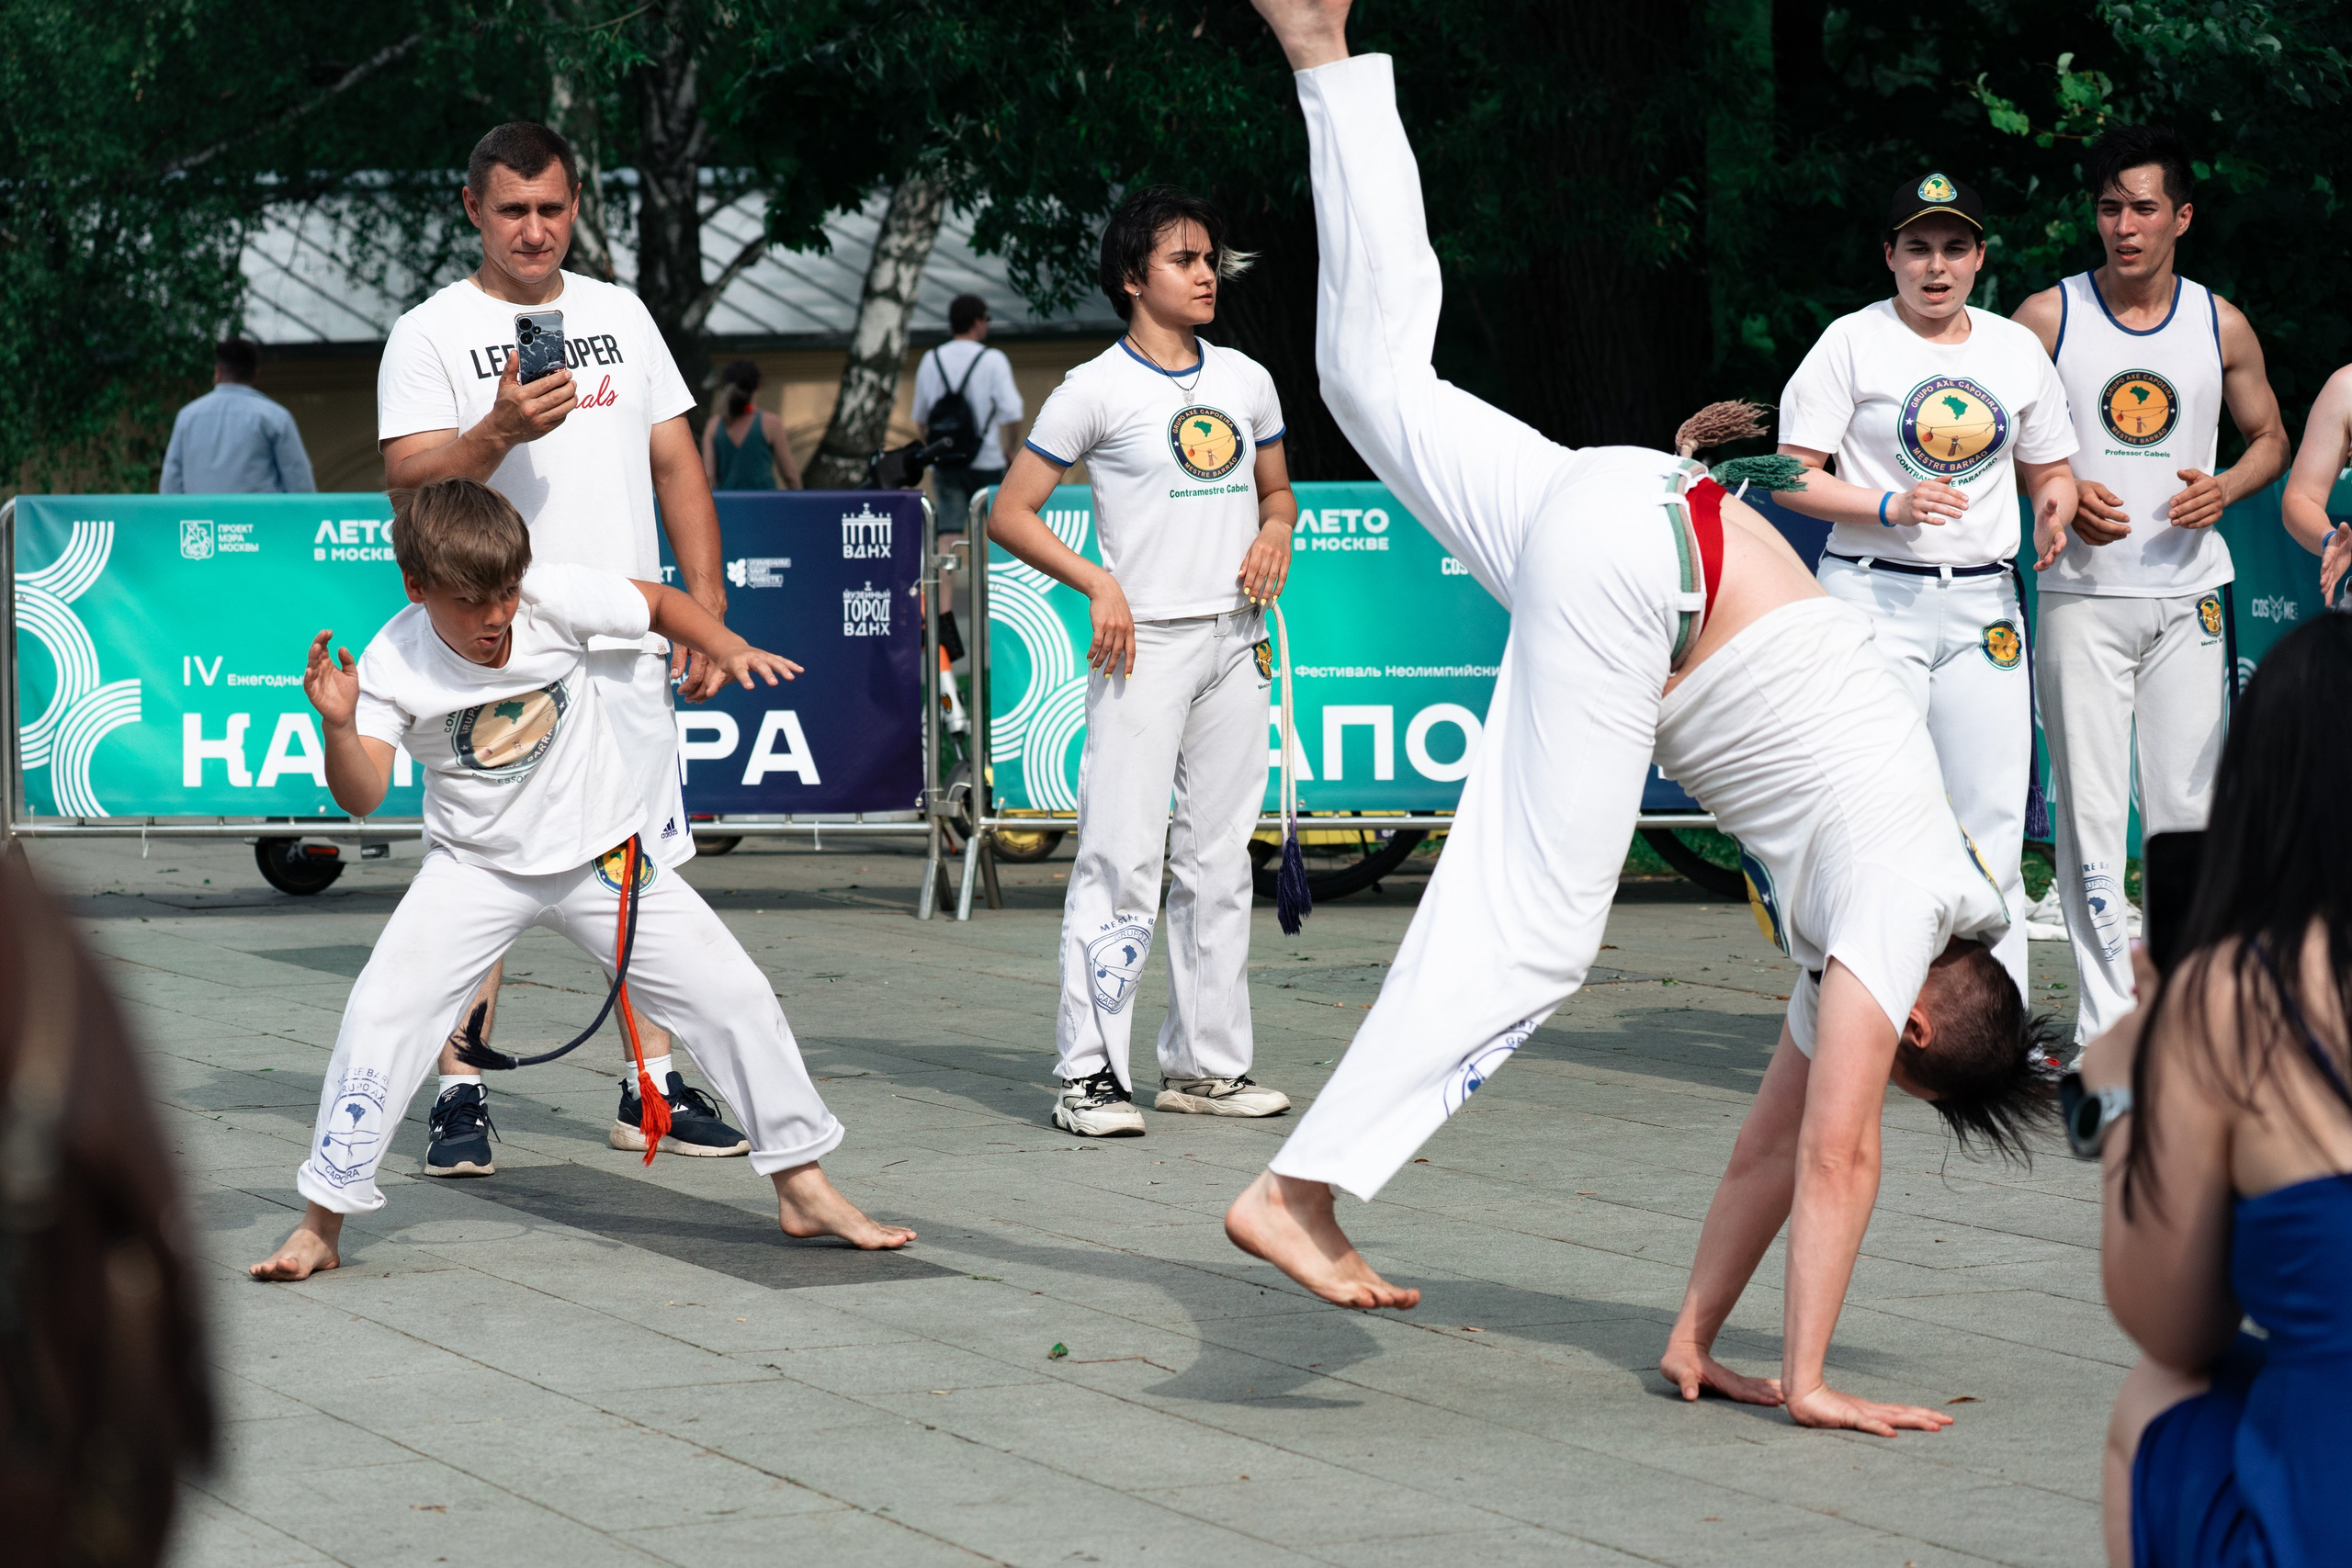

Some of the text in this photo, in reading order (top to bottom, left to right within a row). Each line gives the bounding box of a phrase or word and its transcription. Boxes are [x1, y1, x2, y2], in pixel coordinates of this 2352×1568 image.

[566, 334, 624, 369] OPER
[2106, 378, 2125, 398] GRUPO
[2143, 374, 2174, 400] CAPOEIRA
[1911, 387, 1934, 408] GRUPO
[1958, 380, 1999, 413] CAPOEIRA
[1172, 415, 1185, 434] GRUPO
[1200, 409, 1234, 428] CAPOEIRA
[2111, 426, 2137, 444] MESTRE
[1913, 447, 1946, 471] MESTRE
[1184, 462, 1210, 478] MESTRE
[1958, 457, 1998, 486] PARAFUSO
[1170, 483, 1249, 499] Contramestre Cabelo
[218, 524, 254, 533] ПРОЕКТ
[1295, 508, 1390, 534] ЛЕТО
[218, 534, 244, 542] МЭРА
[1295, 537, 1390, 551] В МОСКВЕ
[218, 543, 259, 552] МОСКВЫ
[313, 547, 396, 561] В МОСКВ
[842, 544, 891, 558] ВДНХ
[842, 599, 891, 622] ГОРОД
[843, 622, 890, 637] ВДНХ
[184, 655, 223, 686] IV
[1295, 664, 1382, 678] Фестиваль
[1385, 663, 1500, 678] Неолимпийски
[227, 672, 304, 687] Ежегодны
[661, 829, 678, 839] adidas
